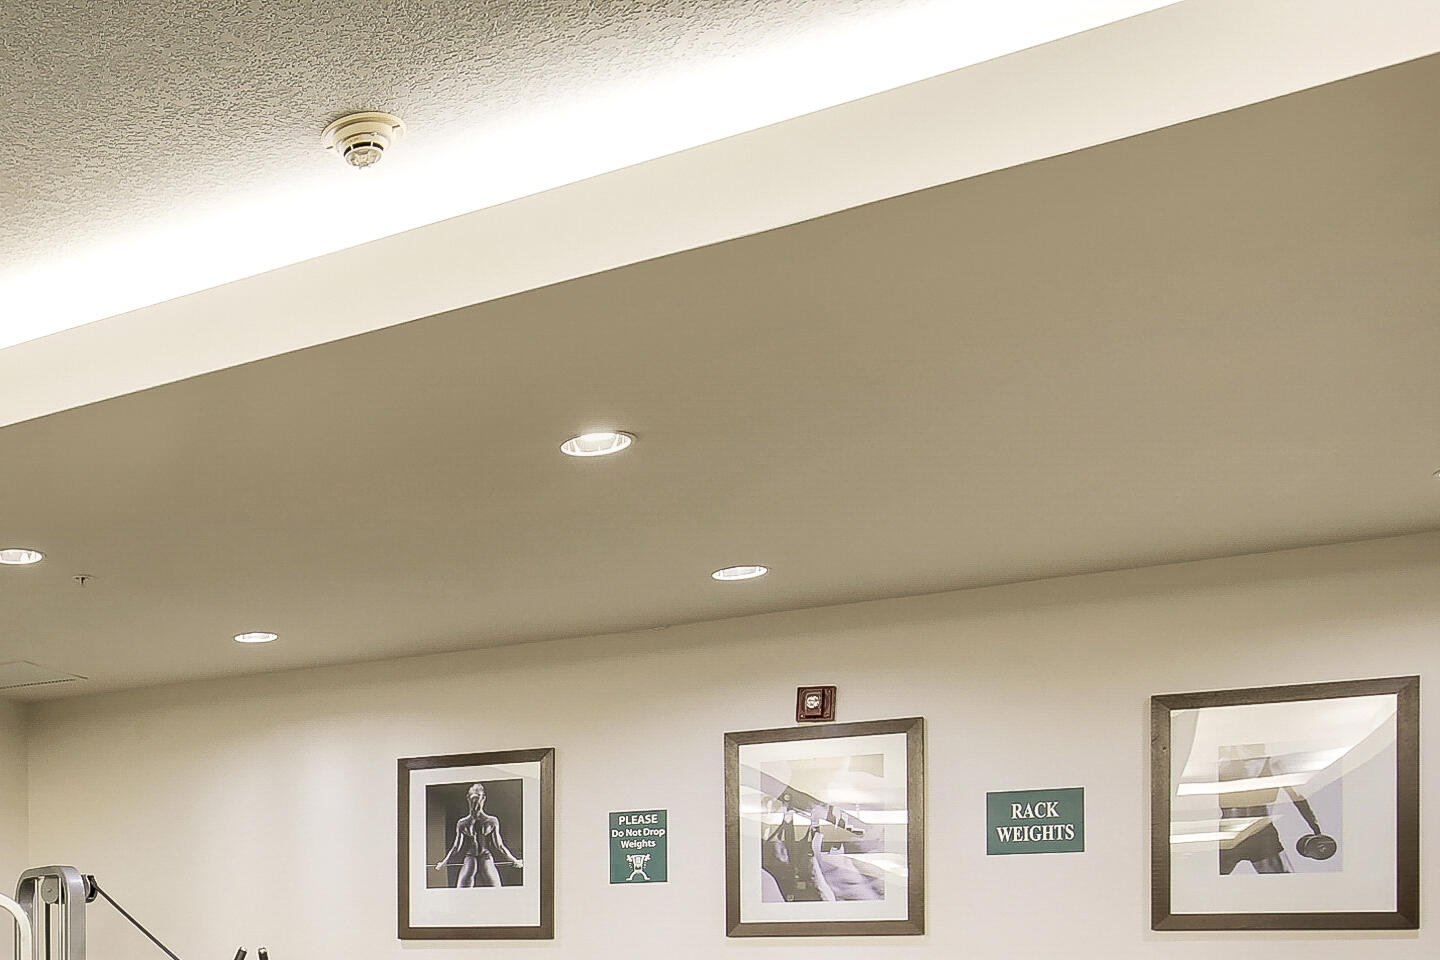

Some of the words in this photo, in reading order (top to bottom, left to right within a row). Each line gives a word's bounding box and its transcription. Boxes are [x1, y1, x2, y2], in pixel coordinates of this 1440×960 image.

[1011, 801, 1060, 819] RACK
[618, 814, 658, 825] PLEASE
[611, 829, 624, 837] Do
[626, 828, 642, 837] Not
[643, 827, 666, 837] Drop
[996, 824, 1075, 842] WEIGHTS
[620, 839, 656, 849] Weights
